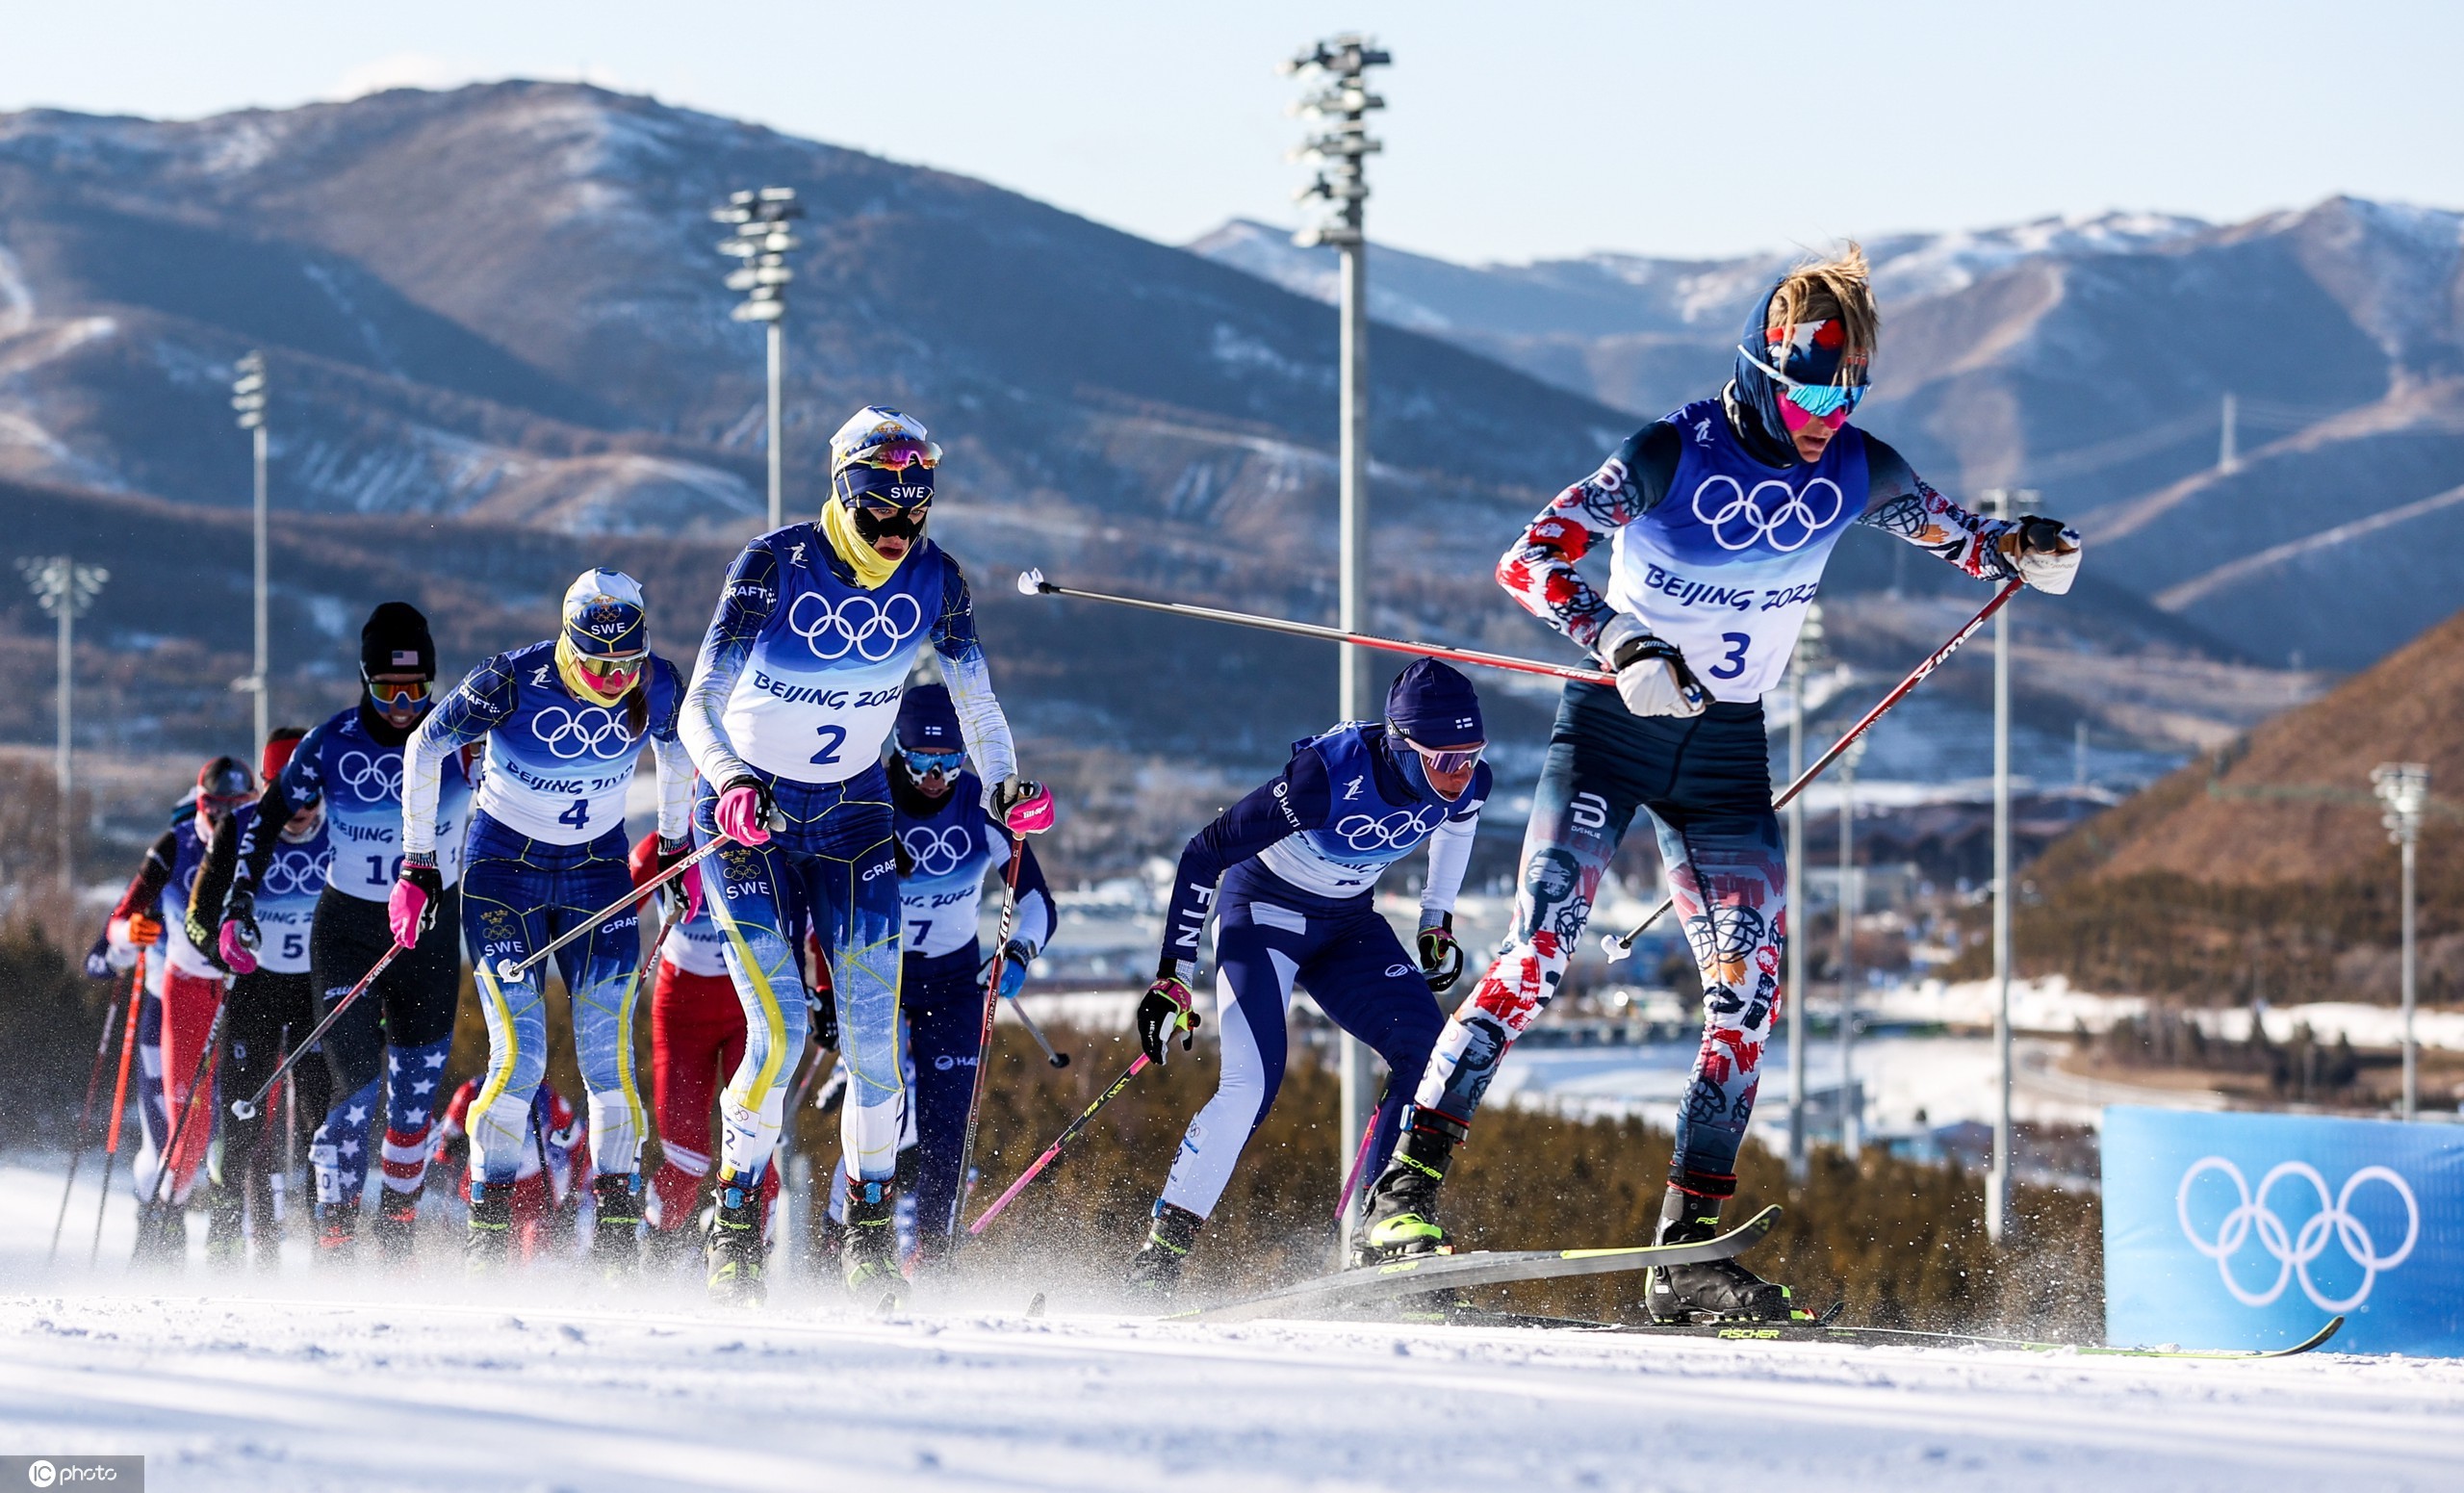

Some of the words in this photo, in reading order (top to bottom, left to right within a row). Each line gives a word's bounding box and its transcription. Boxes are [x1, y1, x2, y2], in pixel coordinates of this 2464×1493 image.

[890, 486, 925, 499] SWE
[1644, 563, 1755, 611] BEIJING
[1760, 581, 1818, 612] 2022
[590, 622, 627, 635] SWE
[1708, 631, 1752, 680] 3
[1914, 616, 1984, 684] SWIX
[753, 670, 850, 710] BEIJING
[809, 724, 847, 765] 2
[557, 798, 590, 831] 4
[1279, 796, 1301, 828] HALTI
[677, 844, 716, 872] SWIX
[861, 857, 897, 882] CRAF
[726, 881, 770, 900] SWE
[602, 915, 639, 935] CRAF
[995, 882, 1014, 963] SWIX
[1175, 882, 1215, 947] FIN
[282, 933, 304, 959] 5
[908, 920, 933, 946] 7
[484, 940, 525, 957] SWE
[366, 956, 393, 984] SWIX
[957, 1055, 980, 1068] HAL
[1392, 1150, 1444, 1182] SCHER
[714, 1214, 752, 1230] CHER
[1377, 1261, 1420, 1275] FISCHER
[1717, 1328, 1781, 1340] FISCHER
